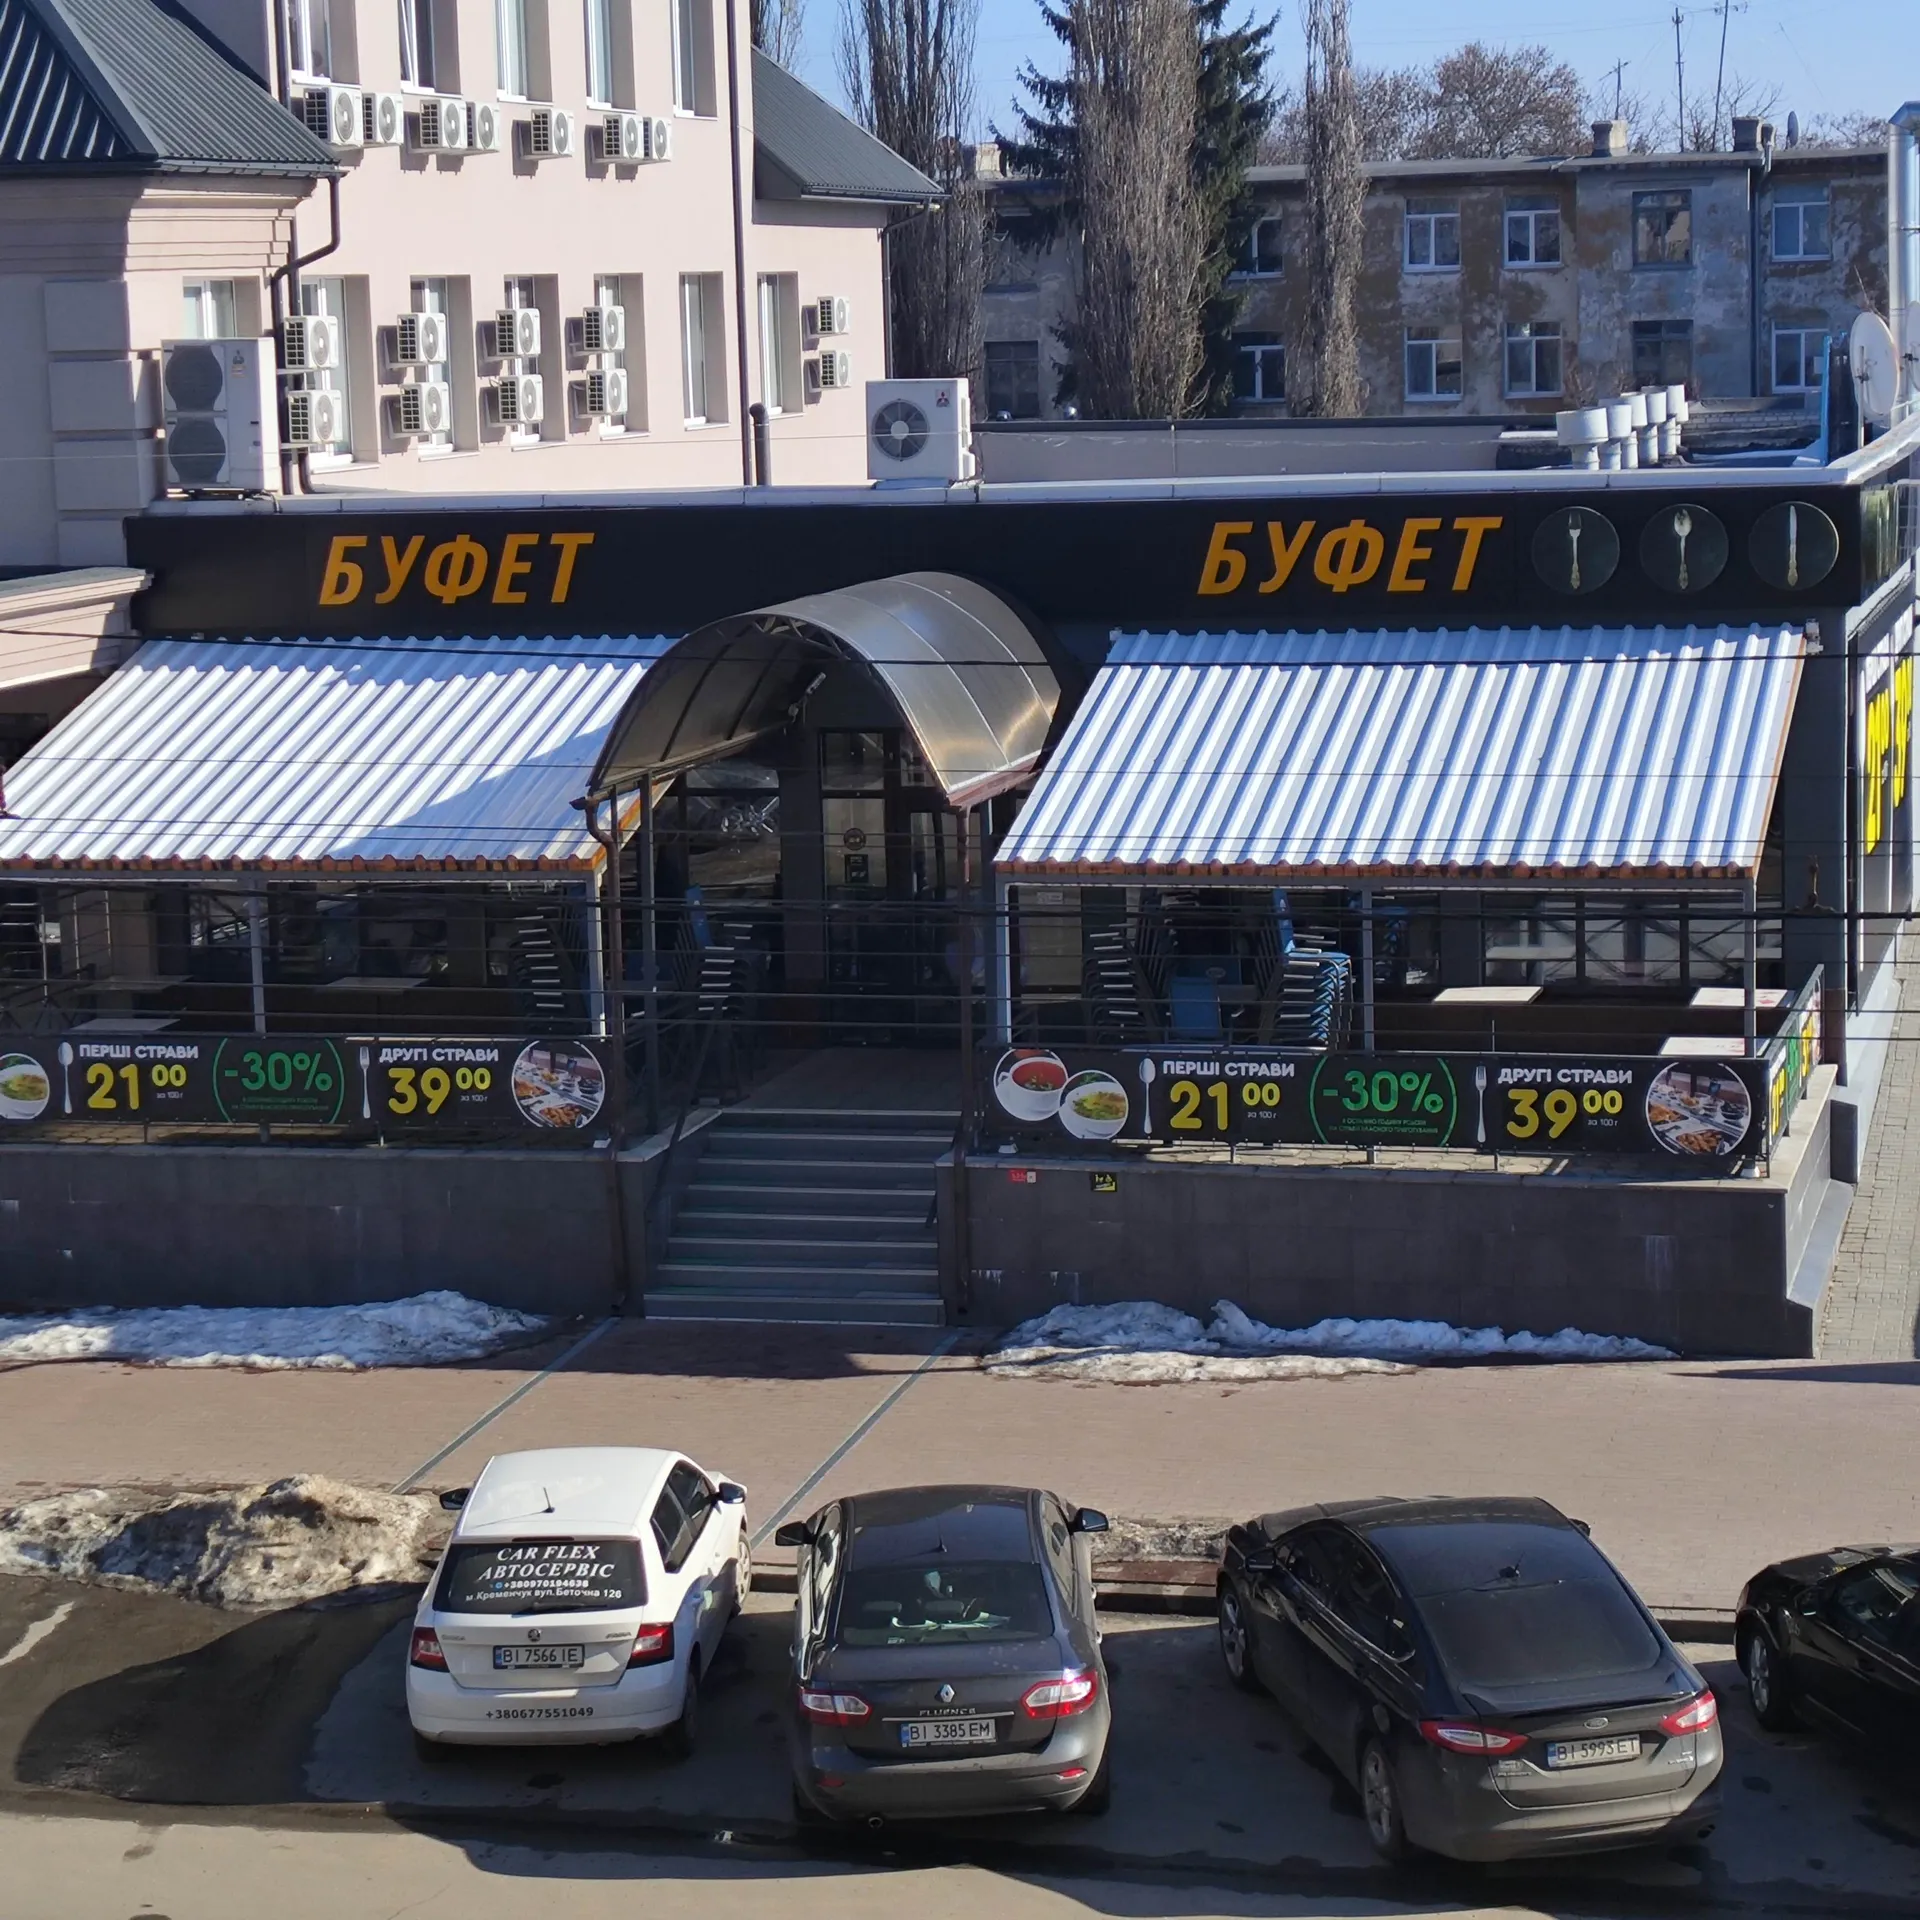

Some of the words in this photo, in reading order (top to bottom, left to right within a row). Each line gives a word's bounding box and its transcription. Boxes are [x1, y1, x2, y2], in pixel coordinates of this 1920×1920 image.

[1197, 516, 1503, 594] БУФЕТ
[319, 532, 595, 605] БУФЕТ
[80, 1044, 131, 1058] ПЕРШІ
[134, 1045, 199, 1059] СТРАВИ
[379, 1047, 428, 1063] ДРУГІ
[432, 1048, 499, 1062] СТРАВИ
[225, 1051, 333, 1091] -30%
[1162, 1060, 1220, 1076] ПЕРШІ
[1224, 1062, 1295, 1077] СТРАВИ
[1498, 1068, 1552, 1084] ДРУГІ
[1556, 1068, 1633, 1084] СТРАВИ
[86, 1062, 140, 1110] 21
[151, 1064, 187, 1087] 00
[388, 1067, 451, 1114] 39
[455, 1067, 491, 1090] 00
[1323, 1070, 1444, 1113] -30%
[1170, 1080, 1229, 1131] 21
[1242, 1082, 1281, 1107] 00
[1506, 1088, 1577, 1139] 39
[1582, 1089, 1623, 1114] 00
[1258, 1111, 1272, 1119] 100
[1600, 1118, 1614, 1127] 100
[497, 1547, 538, 1561] CAR
[542, 1545, 600, 1560] FLEX
[477, 1562, 616, 1581] АВТОСЕРВІС
[503, 1649, 520, 1663] BI
[525, 1648, 557, 1663] 7566
[562, 1648, 578, 1662] IE
[486, 1706, 594, 1720] +380677551049
[920, 1707, 976, 1716] FLUENCE
[910, 1725, 927, 1740] BI
[934, 1723, 966, 1739] 3385
[969, 1722, 991, 1737] EM
[1557, 1744, 1575, 1761] BI
[1581, 1741, 1614, 1758] 5993
[1616, 1737, 1638, 1754] ET
